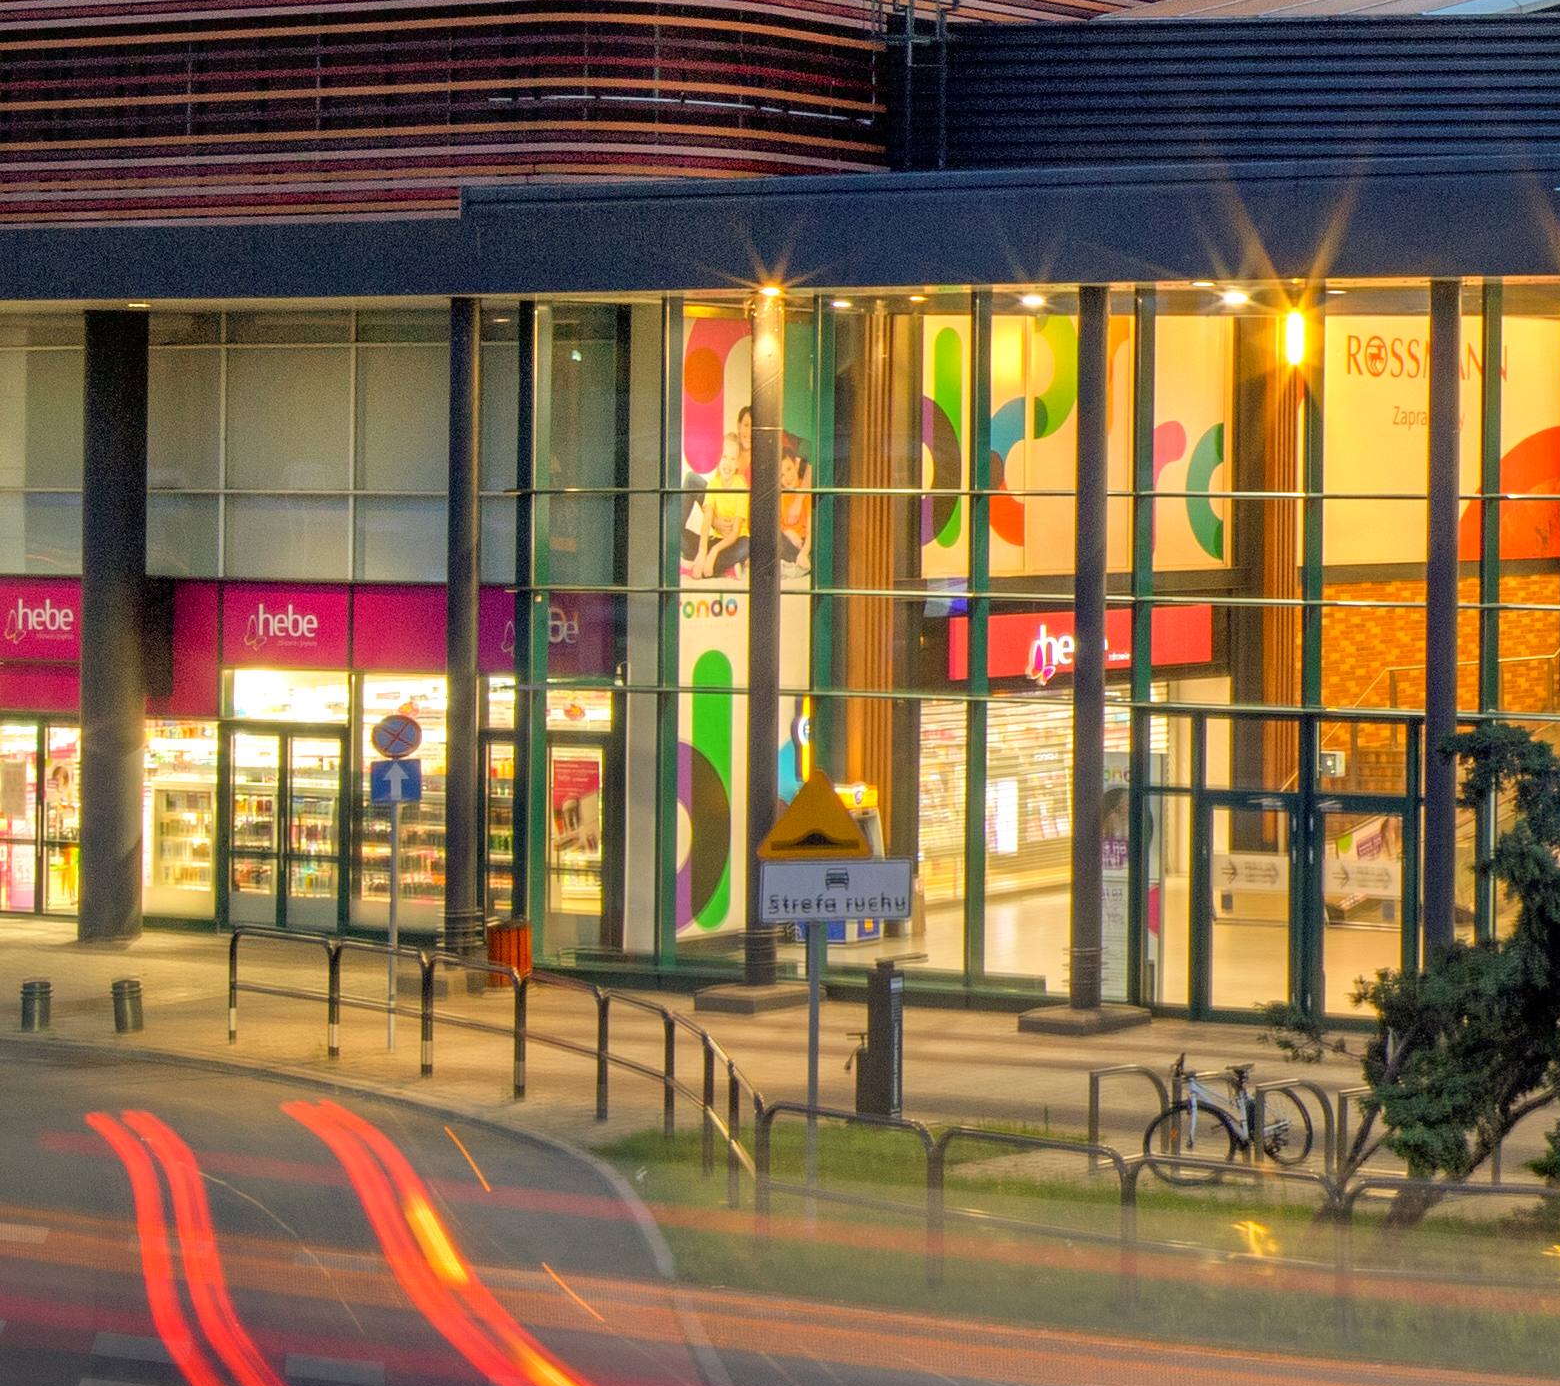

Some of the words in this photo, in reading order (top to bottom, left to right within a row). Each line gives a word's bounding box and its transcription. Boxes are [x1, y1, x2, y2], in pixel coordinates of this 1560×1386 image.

[17, 598, 73, 630] hebe
[257, 603, 318, 637] hebe
[679, 592, 738, 619] ondo
[767, 894, 837, 914] Strefa
[846, 892, 906, 912] ruchu
